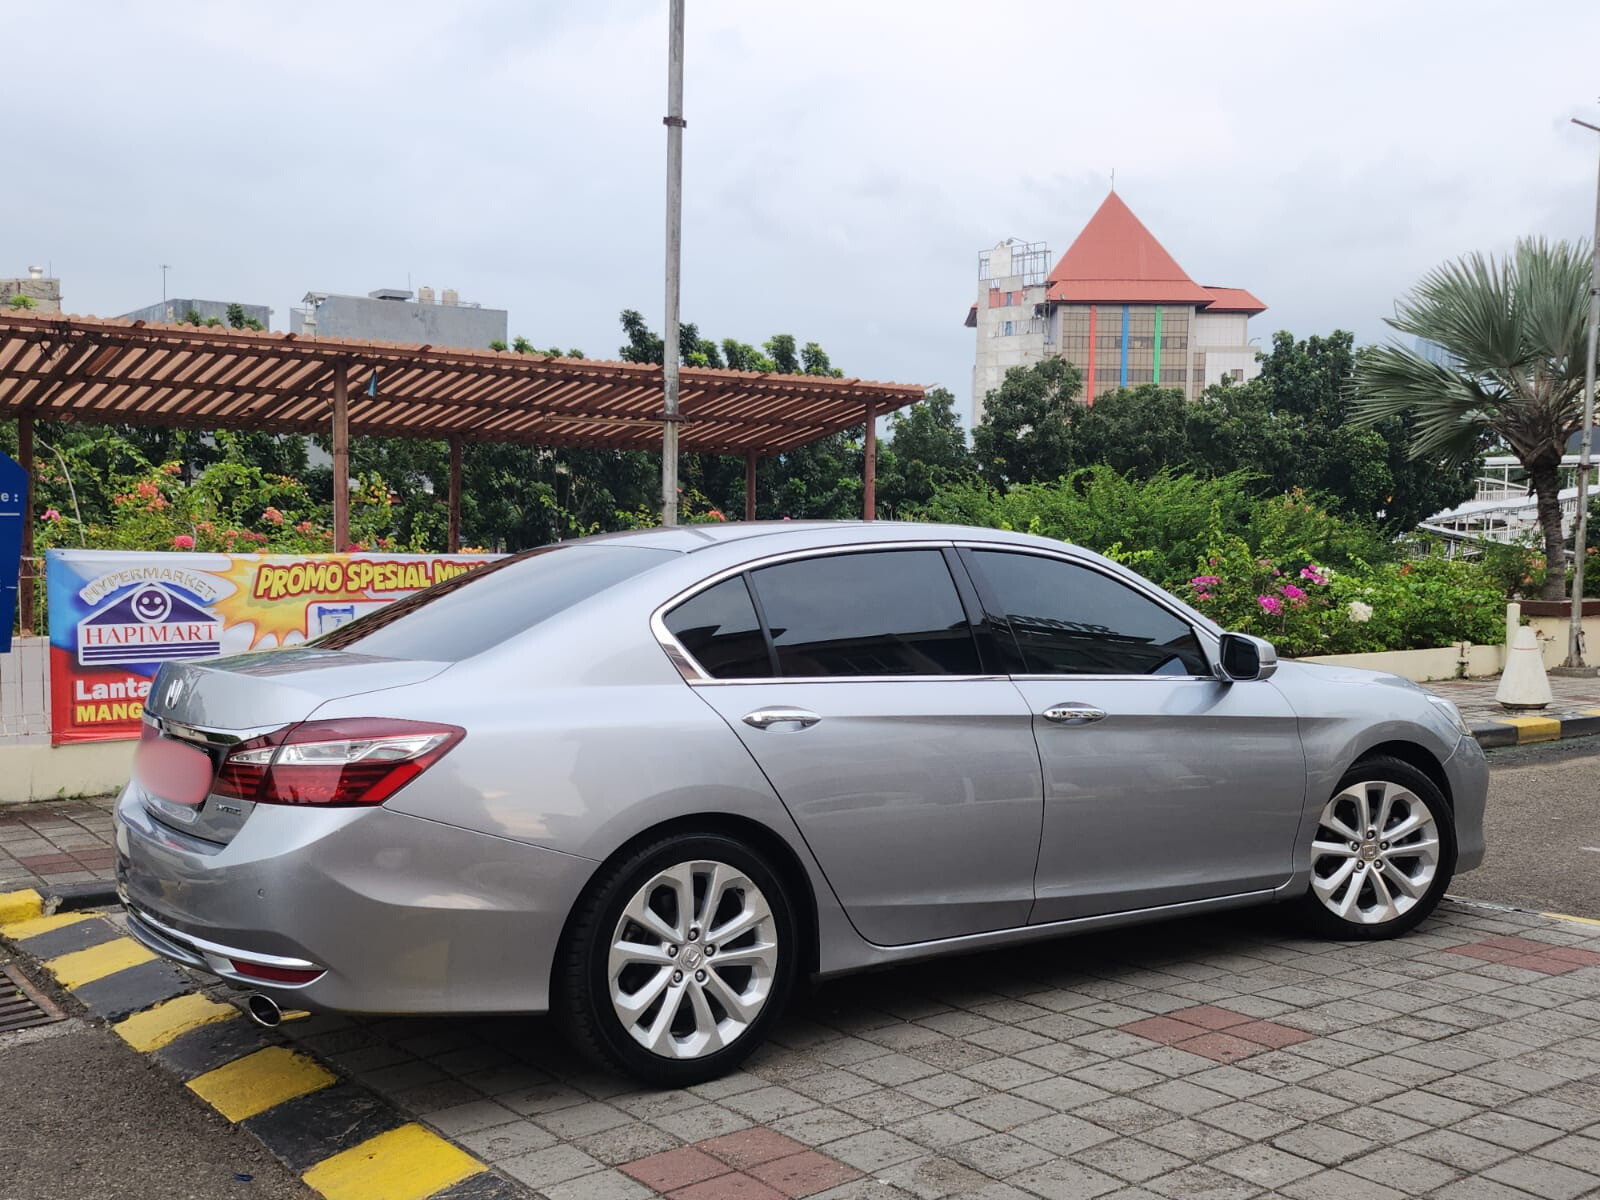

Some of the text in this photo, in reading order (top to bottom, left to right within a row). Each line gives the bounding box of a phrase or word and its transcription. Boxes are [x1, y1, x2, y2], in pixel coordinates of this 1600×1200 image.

[83, 567, 217, 603] HYPERMARKET
[255, 563, 343, 598] PROMO
[346, 561, 431, 592] SPESIAL
[86, 624, 218, 645] HAPIMART
